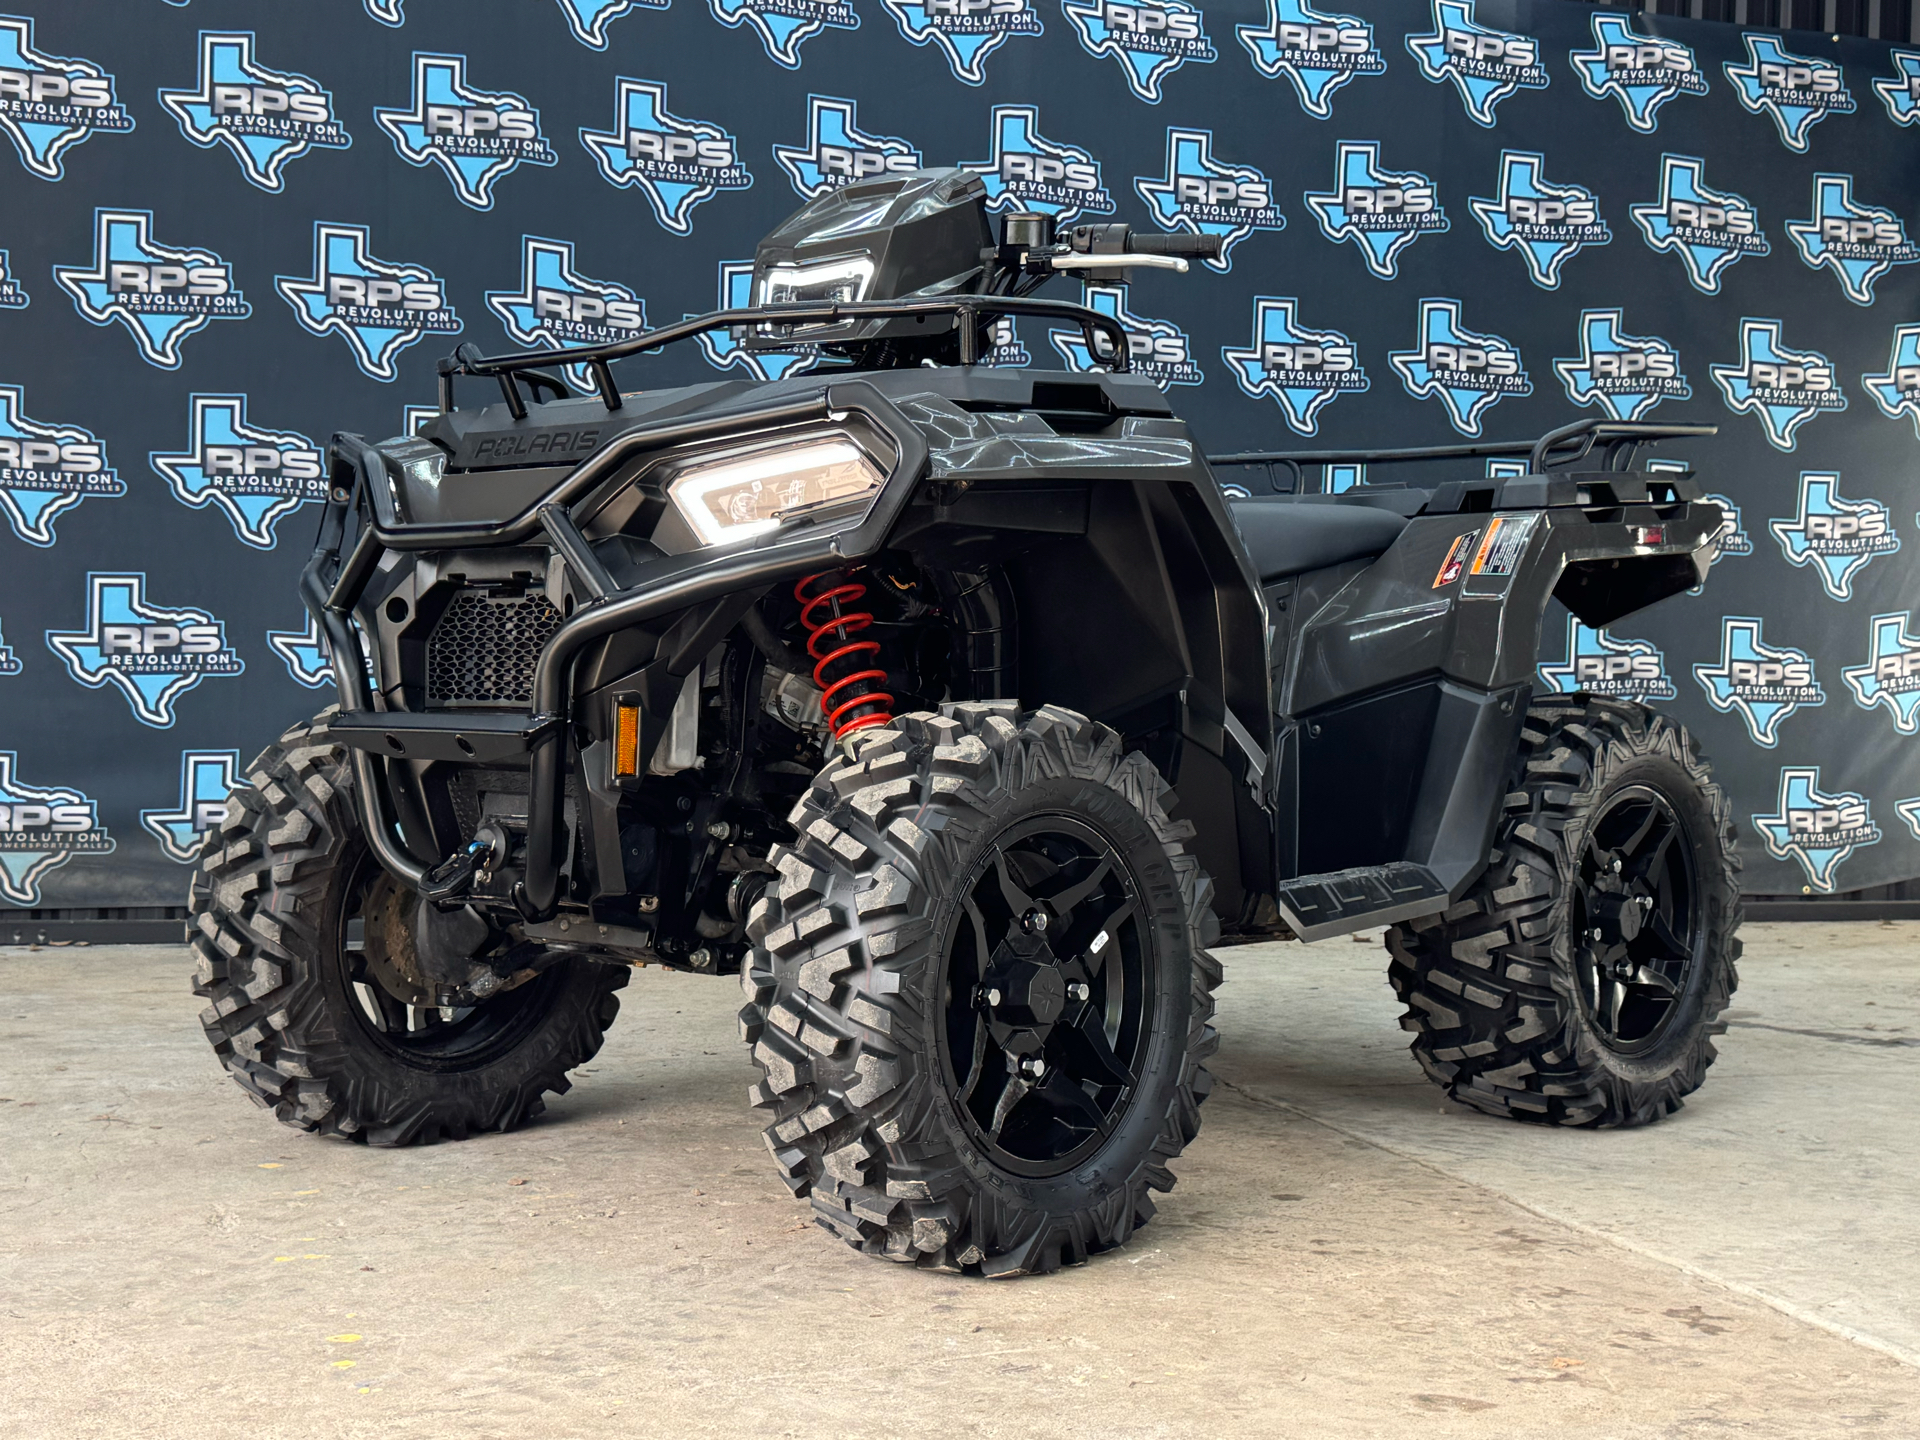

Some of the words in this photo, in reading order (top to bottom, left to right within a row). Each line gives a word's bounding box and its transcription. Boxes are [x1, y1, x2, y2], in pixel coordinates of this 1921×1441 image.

[754, 5, 822, 20] POWERSPORTS
[827, 14, 855, 25] SALES
[933, 13, 1032, 26] REVOLUTION
[1106, 4, 1198, 39] RPS
[941, 23, 1006, 32] POWERSPORTS
[1011, 23, 1039, 32] SALES
[1112, 30, 1205, 51] REVOLUTION
[1279, 24, 1369, 53] RPS
[1120, 41, 1182, 55] POWERSPORTS
[1187, 50, 1212, 58] SALES
[1445, 30, 1533, 66] RPS
[1284, 50, 1375, 64] REVOLUTION
[1292, 59, 1352, 69] POWERSPORTS
[1609, 46, 1691, 71] RPS
[1450, 56, 1539, 78] REVOLUTION
[1457, 66, 1516, 82] POWERSPORTS
[1613, 69, 1698, 83] REVOLUTION
[1761, 64, 1839, 92] RPS
[0, 70, 110, 107] RPS
[1766, 88, 1845, 102] REVOLUTION
[214, 85, 328, 122] RPS
[9, 111, 89, 125] POWERSPORTS
[96, 120, 128, 128] SALES
[222, 114, 336, 135] REVOLUTION
[428, 107, 535, 138] RPS
[231, 125, 308, 139] POWERSPORTS
[314, 135, 345, 144] SALES
[435, 135, 543, 151] REVOLUTION
[443, 146, 517, 156] POWERSPORTS
[522, 151, 552, 162] SALES
[630, 131, 732, 167] RPS
[636, 160, 739, 179] REVOLUTION
[645, 170, 714, 184] POWERSPORTS
[1003, 153, 1097, 190] RPS
[1009, 180, 1103, 202] REVOLUTION
[1178, 177, 1268, 207] RPS
[1016, 190, 1080, 205] POWERSPORTS
[1085, 201, 1110, 210] SALES
[1346, 188, 1432, 213] RPS
[1183, 203, 1274, 219] REVOLUTION
[1190, 213, 1251, 224] POWERSPORTS
[1351, 213, 1438, 223] REVOLUTION
[1509, 200, 1595, 224] RPS
[1672, 201, 1754, 234] RPS
[1515, 224, 1601, 234] REVOLUTION
[1522, 233, 1579, 241] POWERSPORTS
[1677, 226, 1760, 245] REVOLUTION
[1823, 219, 1901, 245] RPS
[1683, 236, 1740, 248] POWERSPORTS
[1828, 242, 1909, 254] REVOLUTION
[111, 264, 228, 294] RPS
[118, 293, 236, 306] REVOLUTION
[330, 277, 441, 310] RPS
[128, 304, 207, 313] POWERSPORTS
[337, 306, 449, 322] REVOLUTION
[537, 290, 641, 329] RPS
[346, 316, 421, 327] POWERSPORTS
[552, 329, 621, 343] POWERSPOR
[1264, 345, 1353, 371] RPS
[1429, 345, 1516, 374] RPS
[1592, 354, 1674, 377] RPS
[1129, 360, 1192, 374] OLUTION
[1270, 370, 1358, 381] REVOLUTION
[1277, 379, 1336, 387] POWERSPORTS
[1434, 370, 1522, 385] REVOLUTION
[1442, 379, 1500, 390] POWERSPORTS
[1597, 378, 1680, 387] REVOLUTION
[1752, 364, 1831, 390] RPS
[1755, 388, 1837, 401] REVOLUTION
[474, 430, 599, 459] POLARIS
[206, 447, 320, 477] RPS
[0, 479, 81, 490] POWERSPORTS
[2, 469, 111, 484] EVOLUTION
[214, 475, 329, 490] REVOLUTION
[223, 485, 300, 494] POWERSPORTS
[1807, 514, 1885, 539] RPS
[1811, 536, 1890, 549] REVOLUTION
[104, 626, 220, 654] RPS
[111, 654, 229, 665] REVOLUTION
[1577, 655, 1659, 680] RPS
[1877, 652, 1920, 681] RP
[1731, 662, 1810, 686] RPS
[1583, 680, 1665, 689] REVOLUTION
[1736, 686, 1815, 695] REVOLUTION
[0, 805, 92, 832] PS
[1789, 806, 1865, 834] RPS
[4, 832, 101, 842] VOLUTION
[1794, 827, 1870, 843] REVOLUTION
